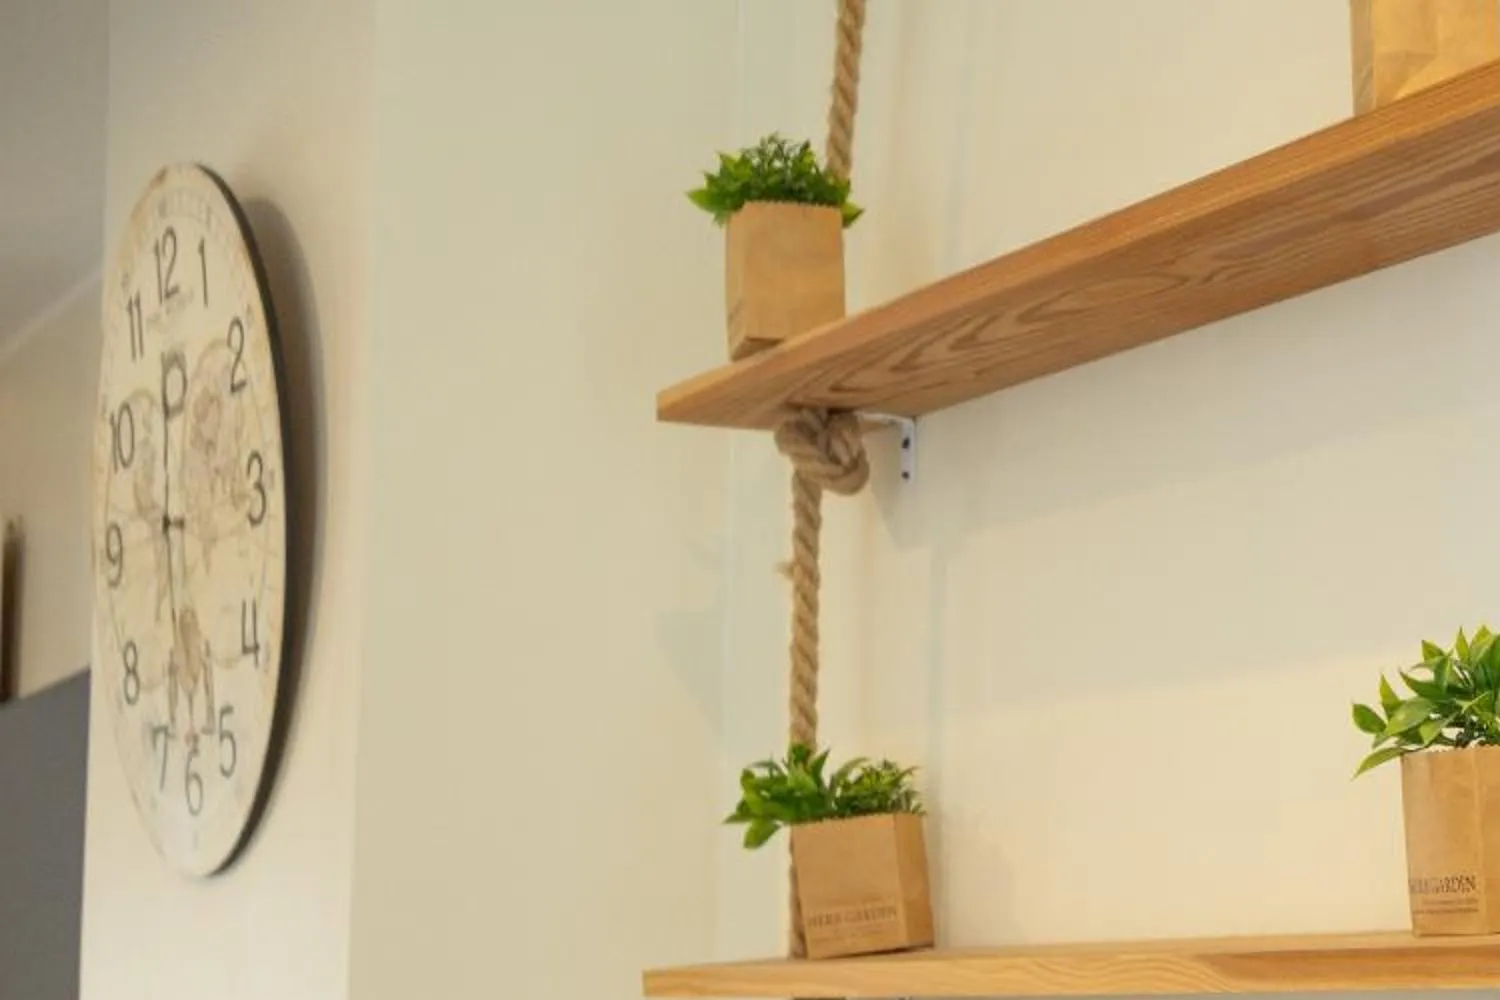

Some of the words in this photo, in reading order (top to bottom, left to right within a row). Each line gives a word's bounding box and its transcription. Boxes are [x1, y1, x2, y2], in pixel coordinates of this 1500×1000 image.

[154, 226, 180, 304] 12
[199, 235, 208, 308] 1
[226, 316, 248, 395] 2
[110, 402, 134, 473] 10
[247, 451, 266, 524] 3
[105, 523, 123, 589] 9
[241, 598, 260, 668] 4
[123, 641, 139, 705] 8
[151, 724, 172, 791] 7
[219, 705, 236, 778] 5
[185, 750, 202, 816] 6
